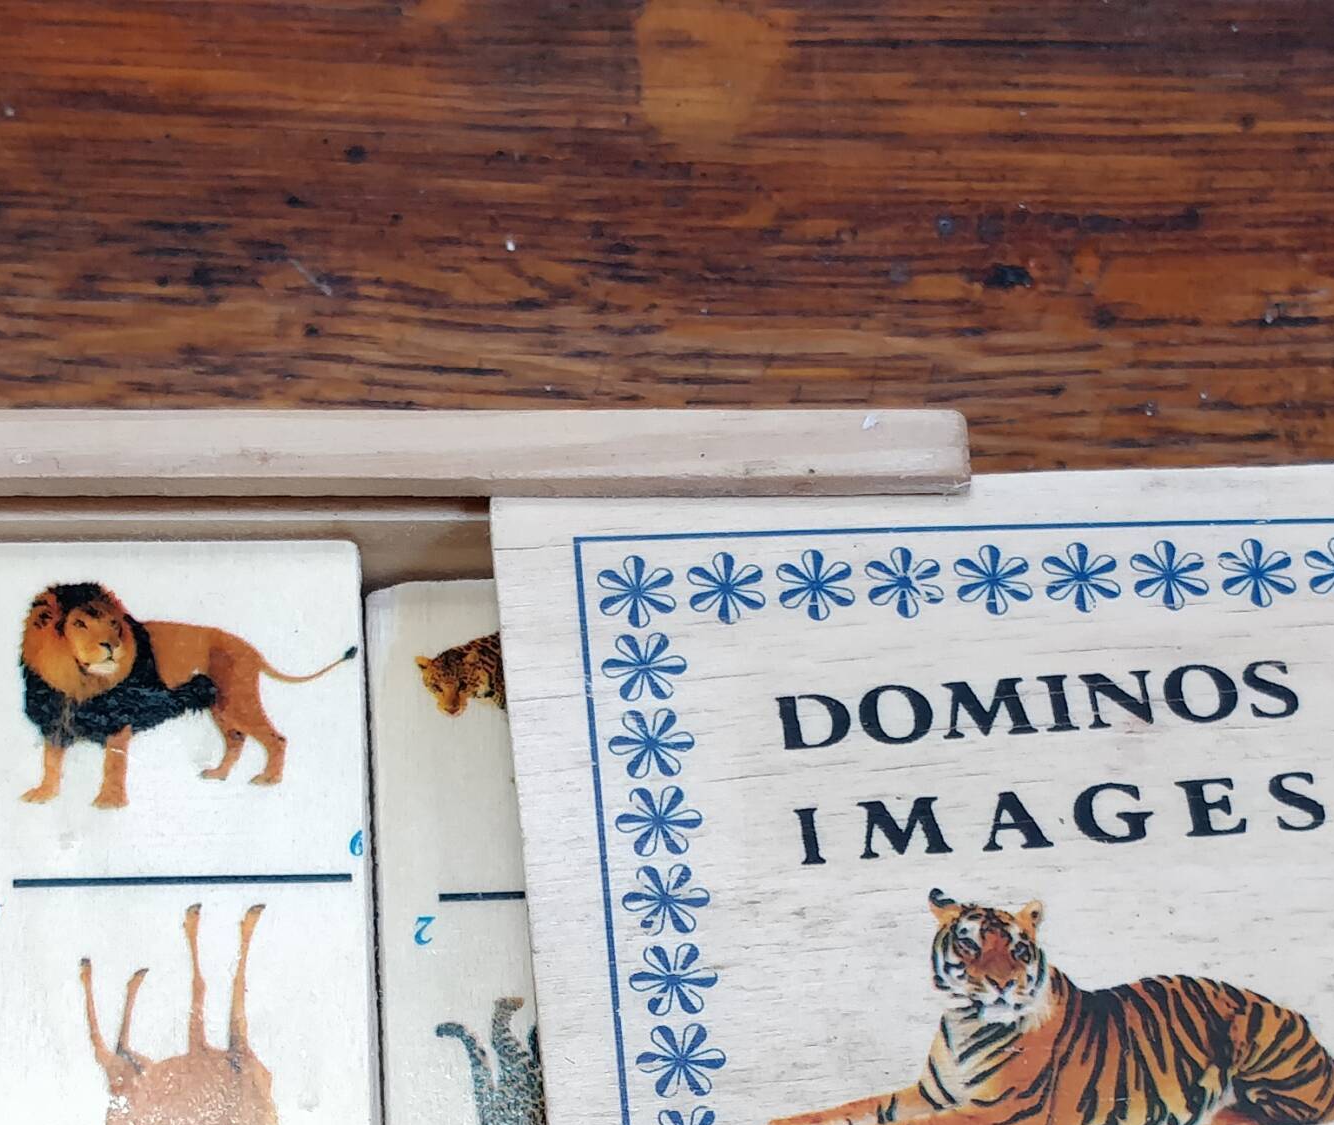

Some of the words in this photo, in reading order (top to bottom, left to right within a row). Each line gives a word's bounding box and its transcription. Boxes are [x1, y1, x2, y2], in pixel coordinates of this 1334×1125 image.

[774, 659, 1300, 751] DOMINOS
[793, 771, 1327, 866] IMAGES
[413, 915, 437, 946] 2
